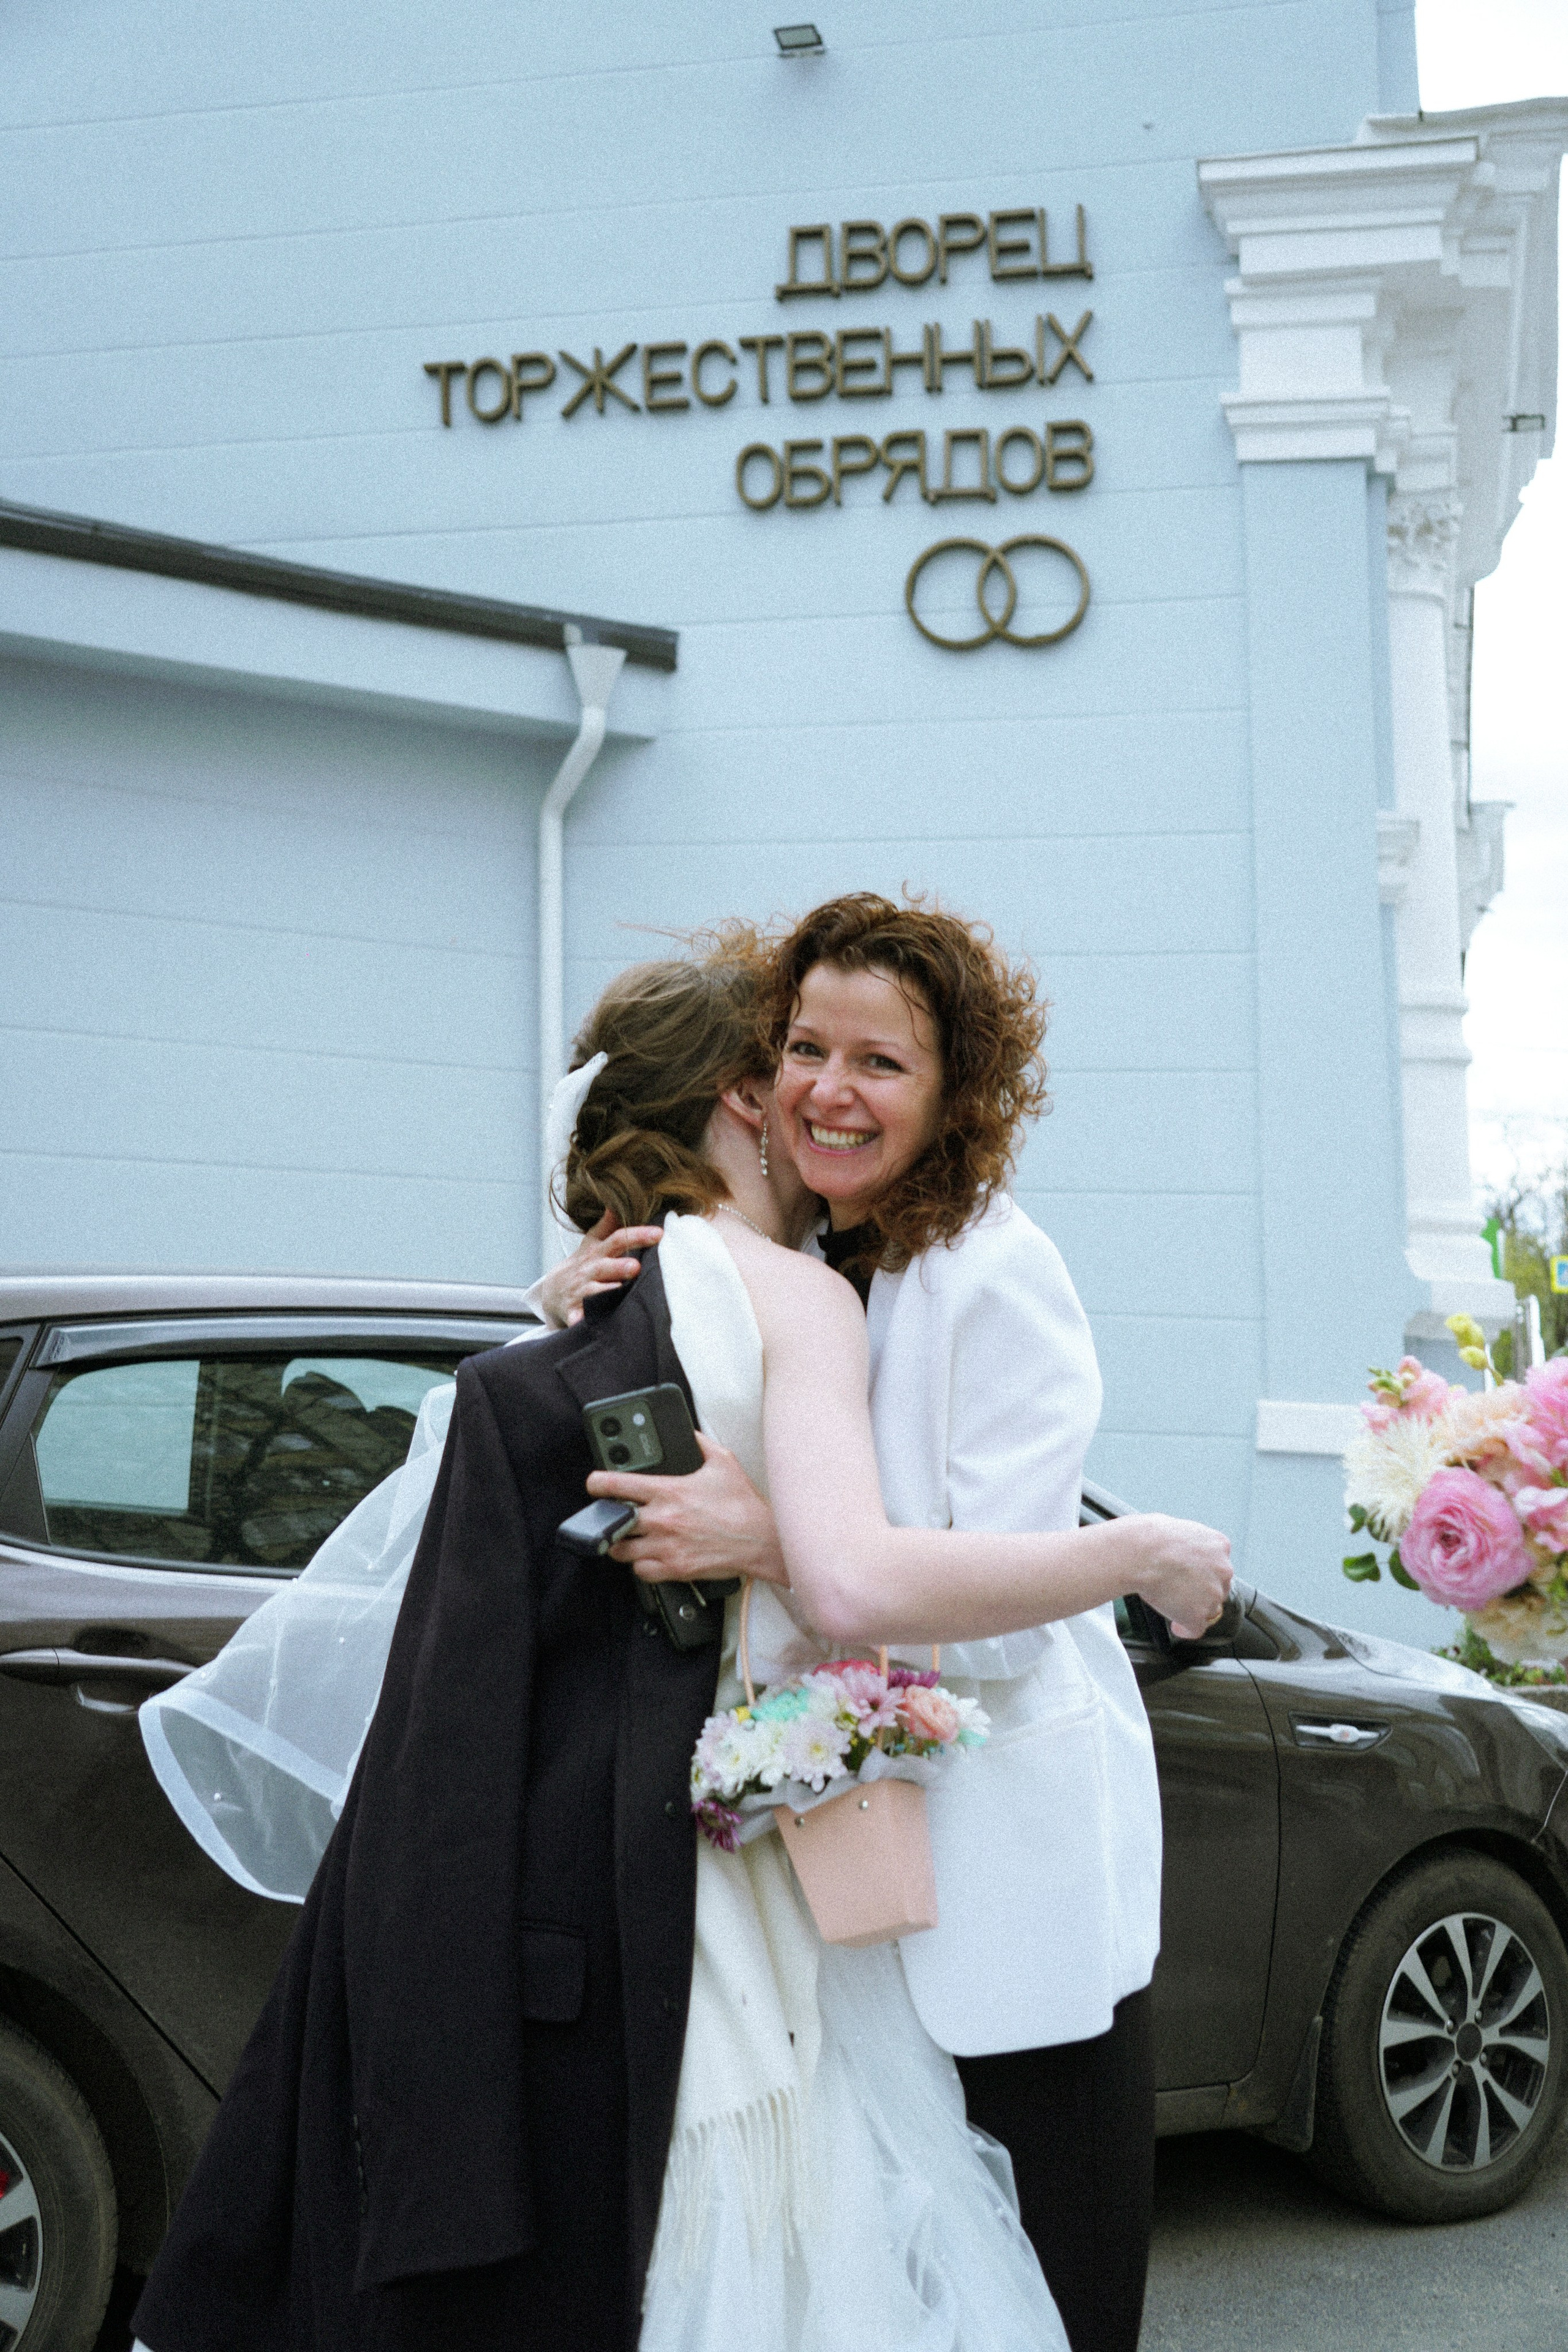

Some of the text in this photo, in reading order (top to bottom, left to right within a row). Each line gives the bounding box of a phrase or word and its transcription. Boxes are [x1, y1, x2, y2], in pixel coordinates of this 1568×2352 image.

[775, 204, 1095, 302] ДВОРЕЦ
[423, 311, 1095, 428] ТОРЖЕСТВЕННЫХ
[736, 420, 1095, 511] ОБРЯДОВ
